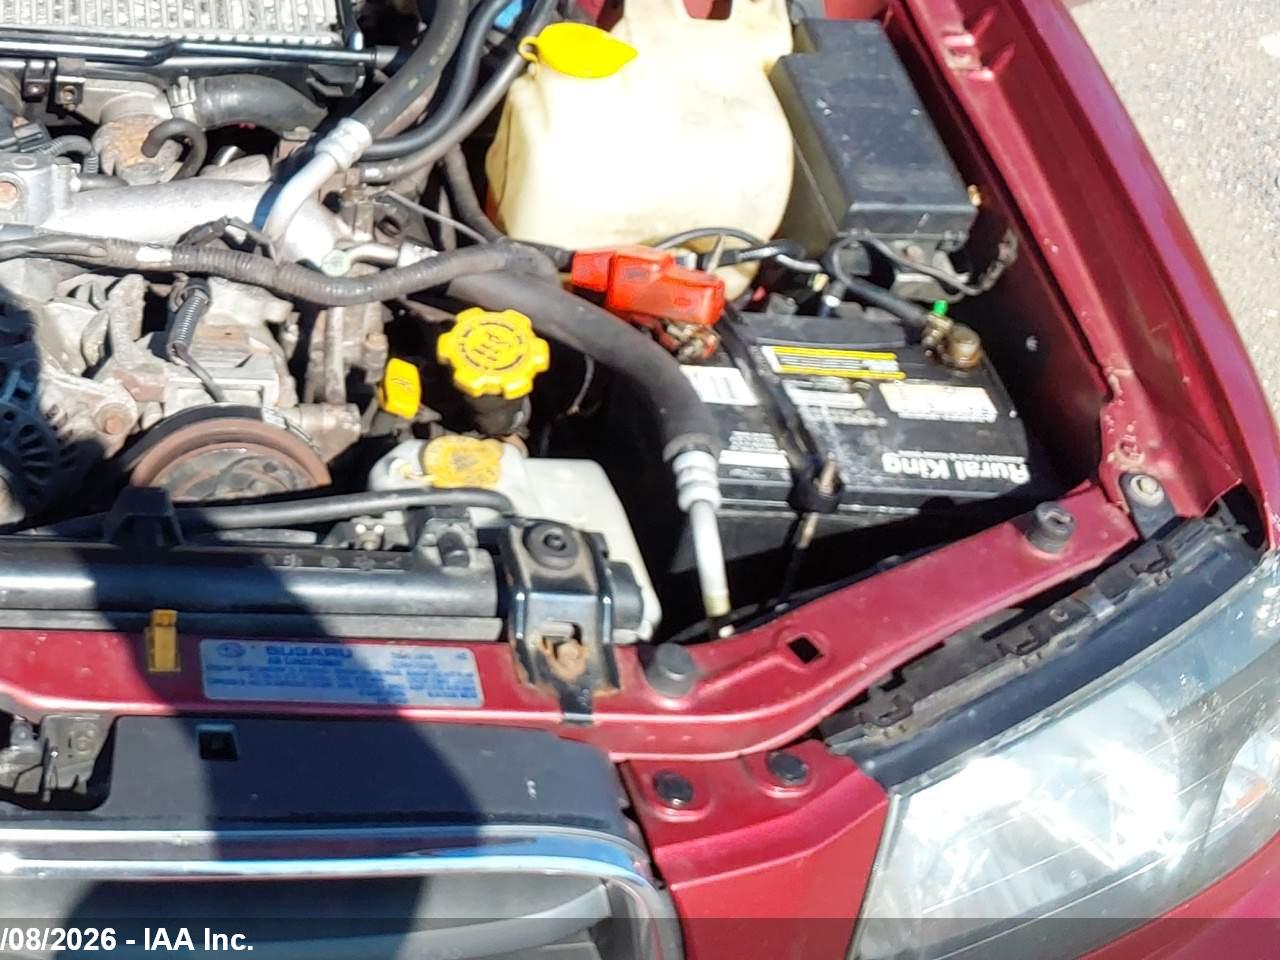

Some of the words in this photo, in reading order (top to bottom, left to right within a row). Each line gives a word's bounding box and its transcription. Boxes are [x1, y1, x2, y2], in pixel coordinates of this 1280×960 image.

[881, 452, 951, 480] King
[954, 460, 1030, 485] Rural
[265, 645, 353, 659] SUBARU
